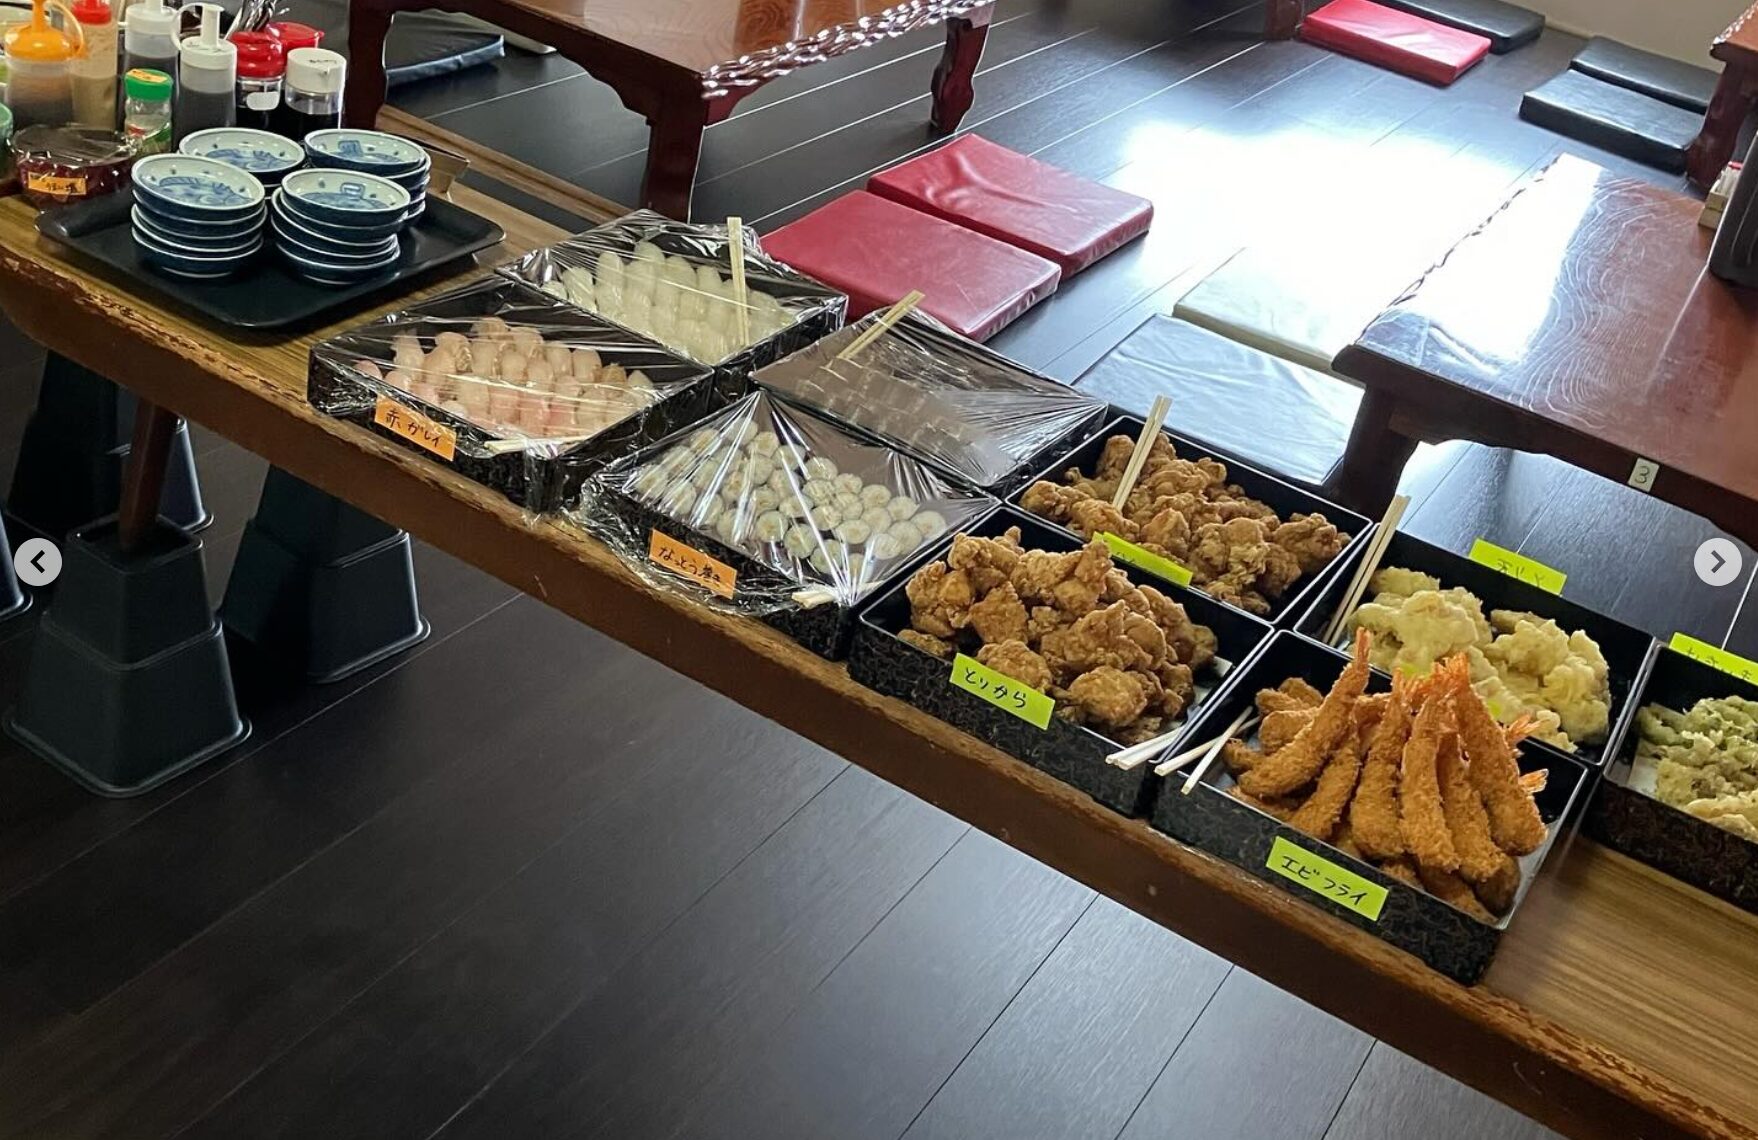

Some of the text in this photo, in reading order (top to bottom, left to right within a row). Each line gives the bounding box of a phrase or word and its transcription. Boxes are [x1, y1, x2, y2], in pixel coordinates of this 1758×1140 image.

[1634, 465, 1650, 484] 3
[964, 667, 1027, 708] とりから
[1281, 855, 1368, 906] エビフライ
